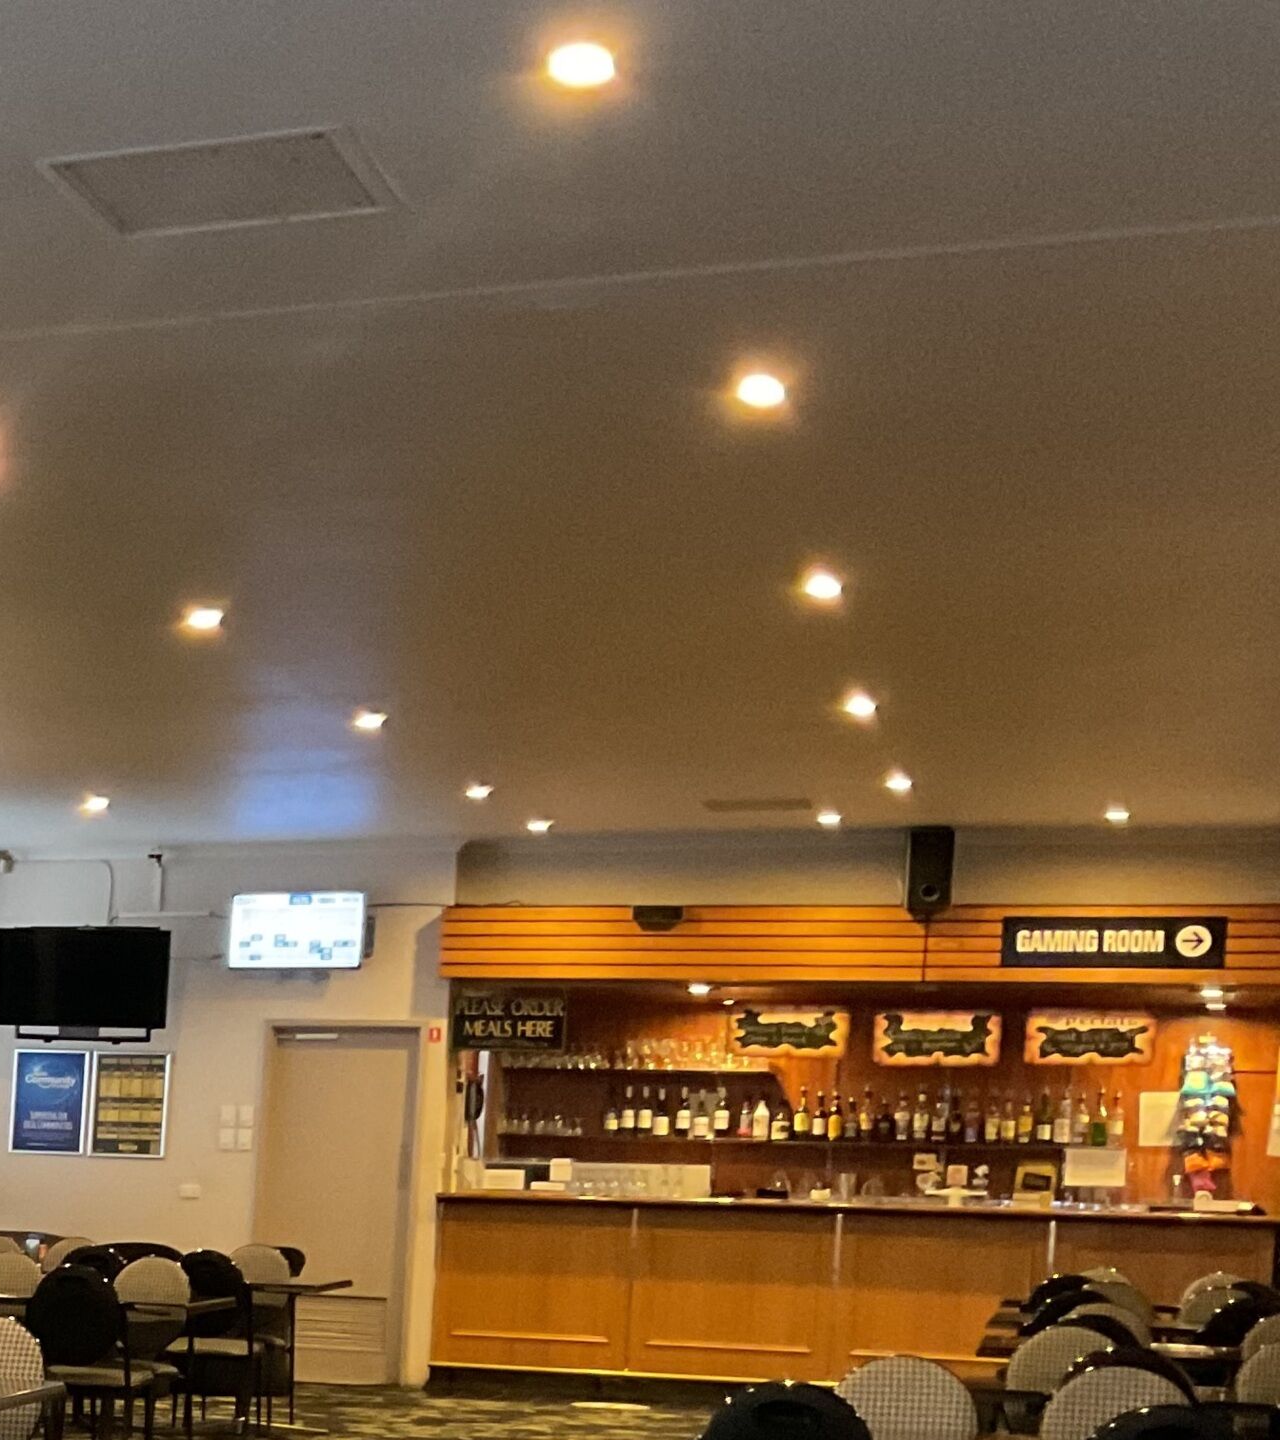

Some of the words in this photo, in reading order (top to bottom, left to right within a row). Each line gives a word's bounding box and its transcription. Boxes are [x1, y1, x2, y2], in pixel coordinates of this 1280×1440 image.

[1016, 929, 1099, 953] GAMING
[1102, 929, 1165, 953] ROOM
[455, 998, 505, 1016] PLEASE
[510, 998, 565, 1016] ORDER
[463, 1020, 513, 1037] MEALS
[517, 1020, 555, 1037] HERE
